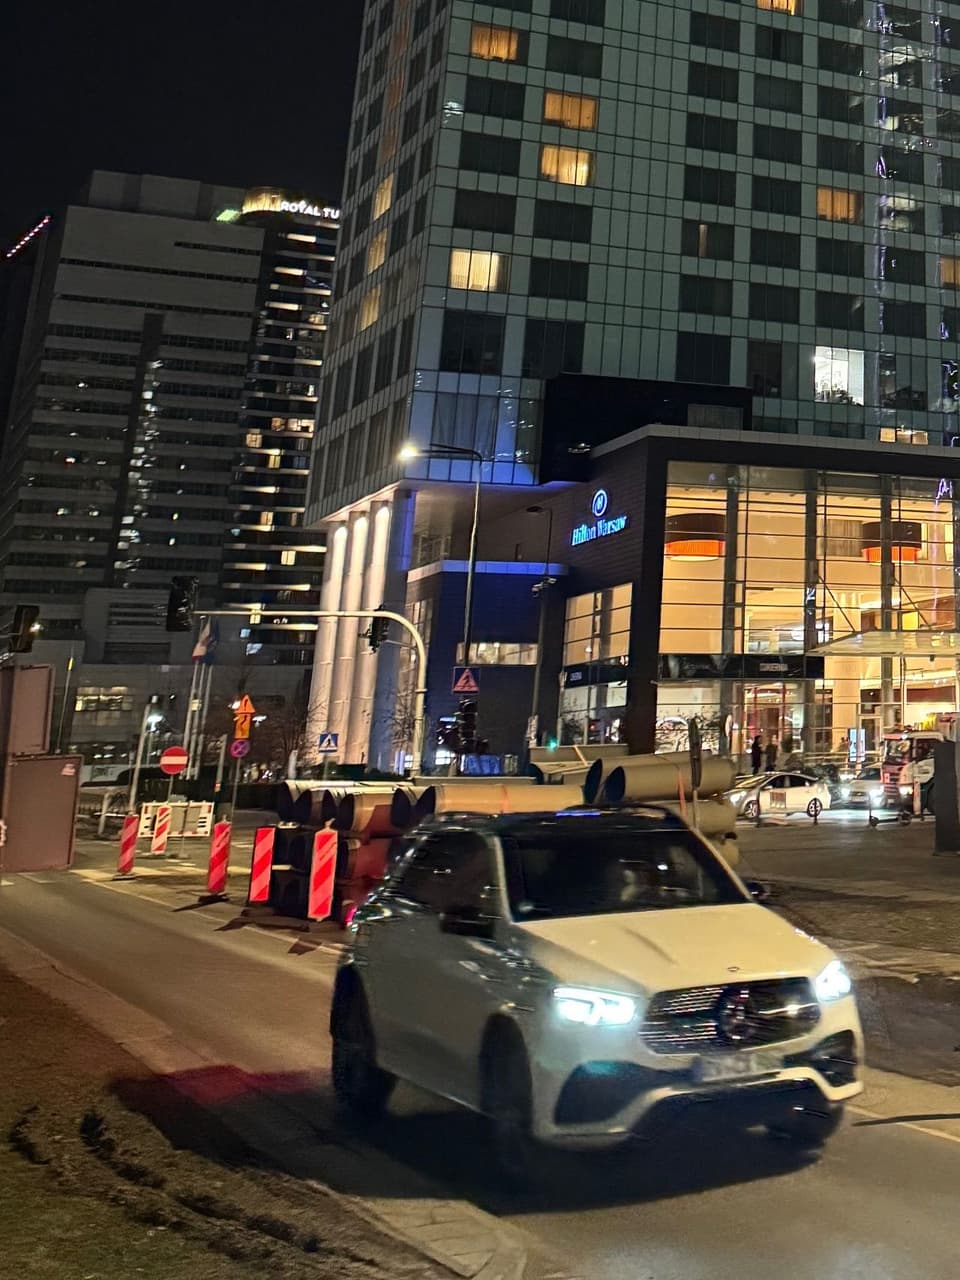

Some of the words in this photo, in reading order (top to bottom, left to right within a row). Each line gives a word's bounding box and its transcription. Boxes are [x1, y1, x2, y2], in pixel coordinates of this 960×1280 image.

[280, 200, 321, 217] ROYAL
[571, 524, 597, 546] Hilton
[597, 515, 627, 537] Warsaw
